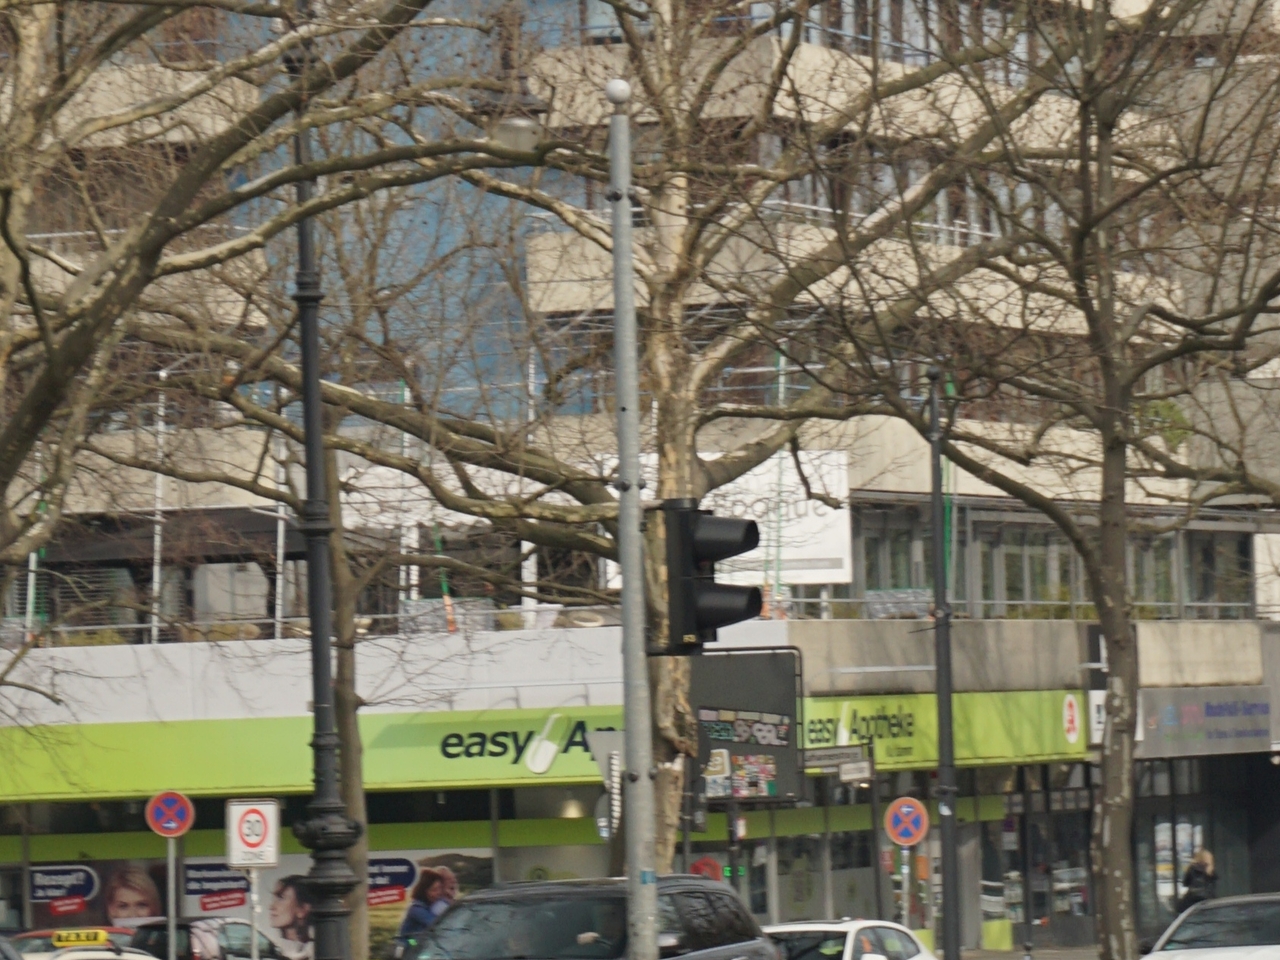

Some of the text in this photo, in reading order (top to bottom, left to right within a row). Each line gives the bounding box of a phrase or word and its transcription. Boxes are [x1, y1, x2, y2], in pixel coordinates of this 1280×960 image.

[850, 705, 913, 742] Apotheke
[441, 730, 534, 764] easy
[244, 819, 262, 838] 30
[242, 851, 264, 861] ZONE
